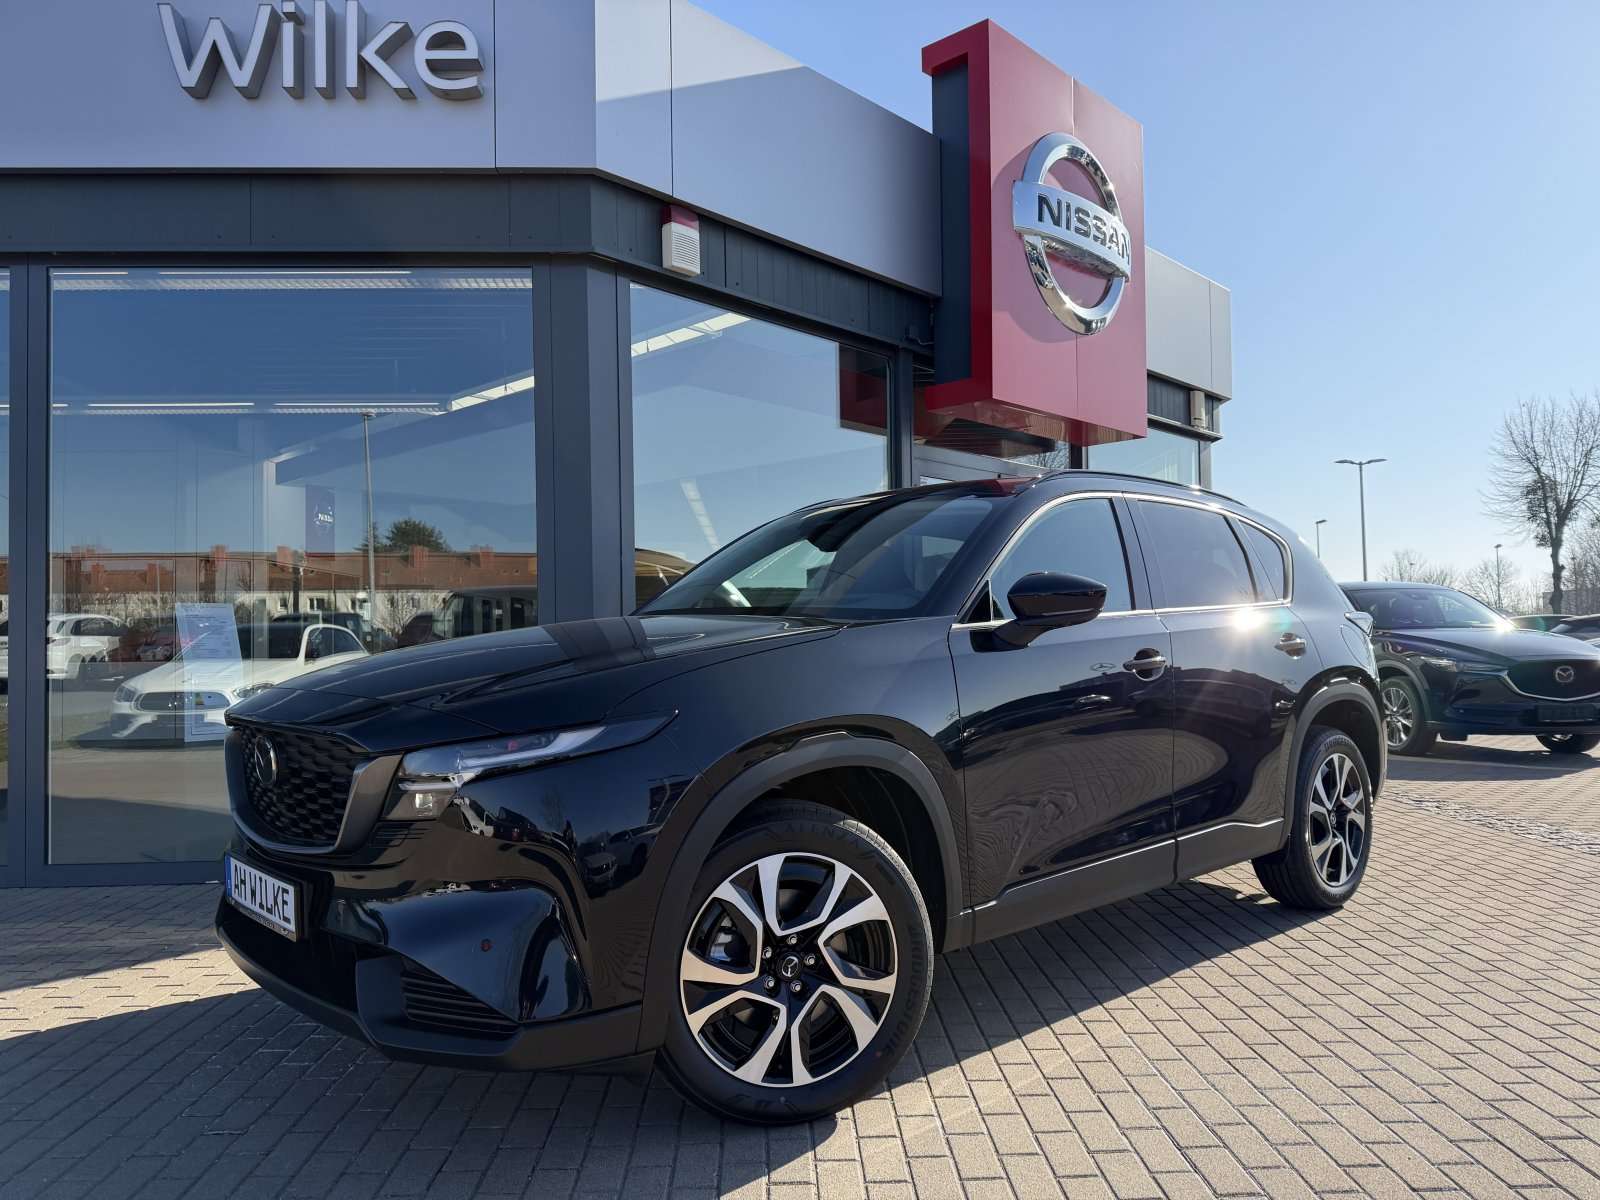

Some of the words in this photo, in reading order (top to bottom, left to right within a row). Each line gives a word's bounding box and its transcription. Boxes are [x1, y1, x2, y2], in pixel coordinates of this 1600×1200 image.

[157, 0, 483, 99] Wilke
[1037, 192, 1131, 265] NISSAN
[249, 871, 291, 924] WILKE
